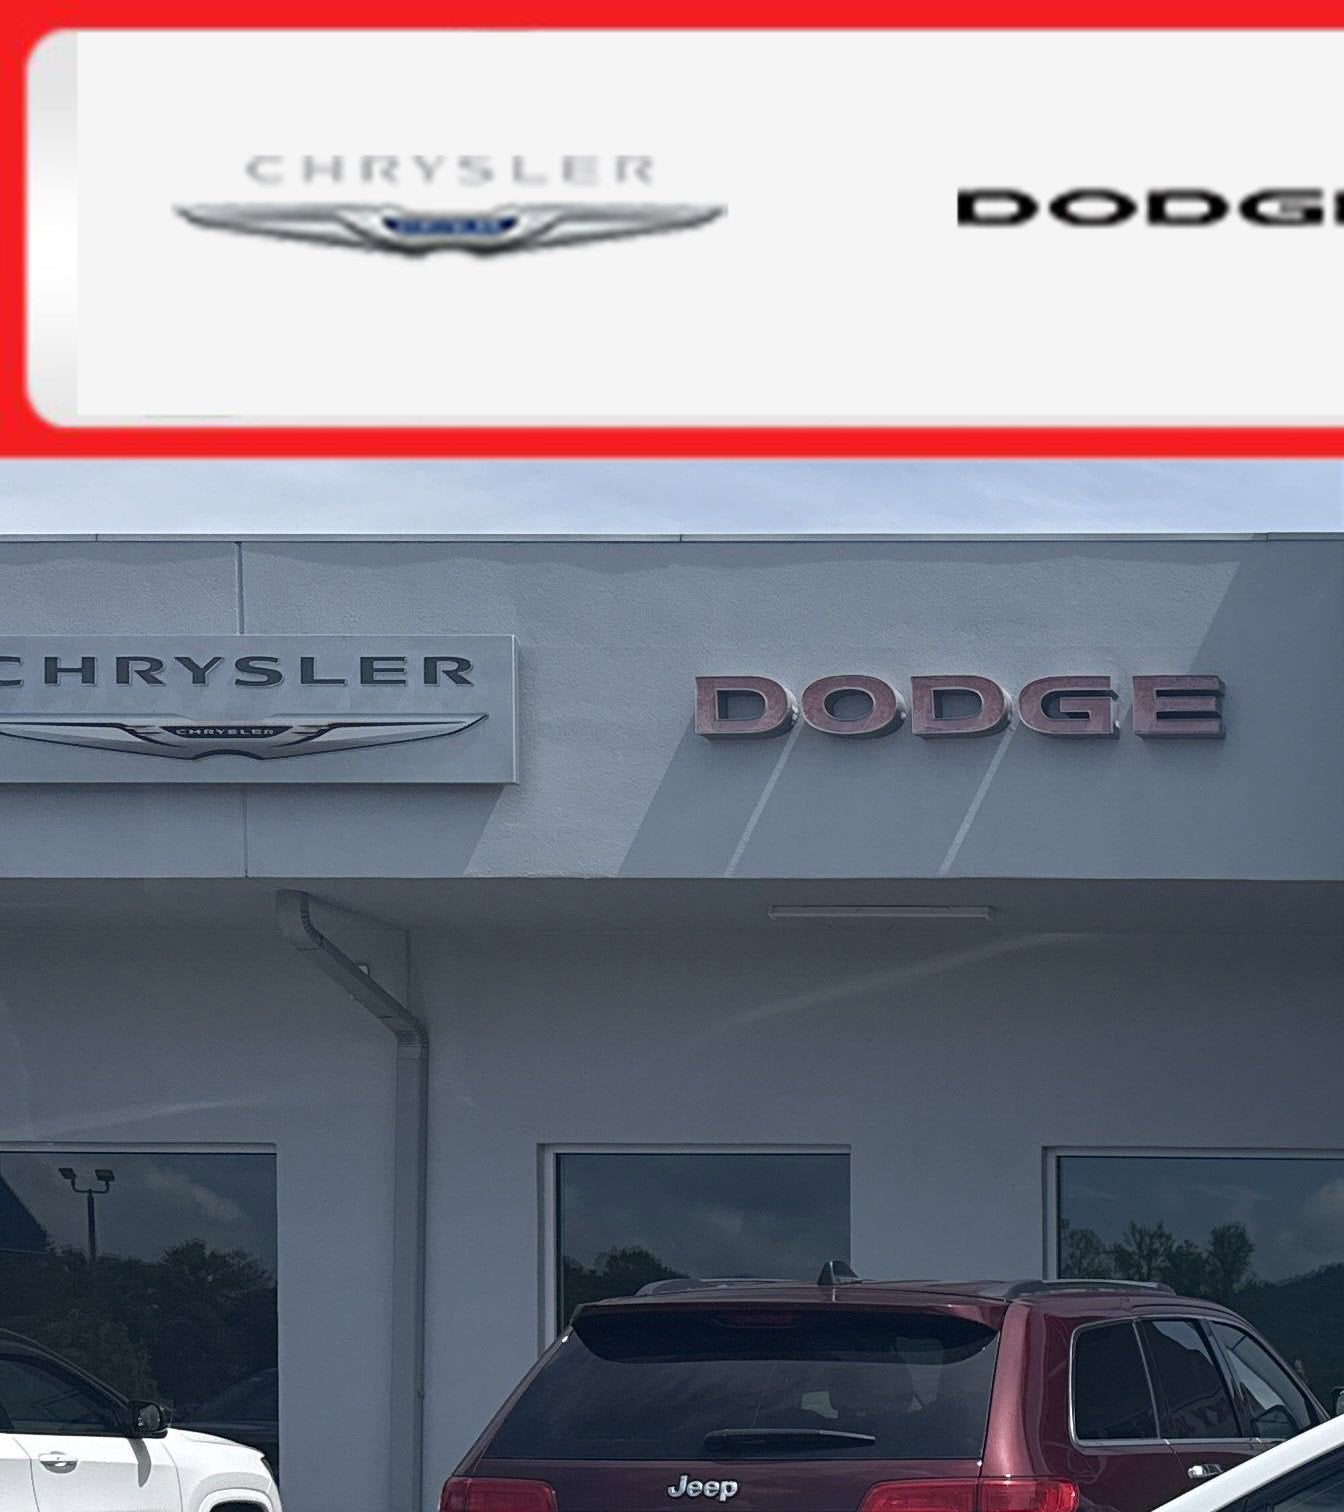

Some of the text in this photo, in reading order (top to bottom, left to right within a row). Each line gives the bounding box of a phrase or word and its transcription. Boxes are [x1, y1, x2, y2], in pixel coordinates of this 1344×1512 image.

[695, 675, 1226, 739] DODGE
[175, 728, 275, 736] CHRYSLER
[667, 1475, 740, 1502] Jeep
